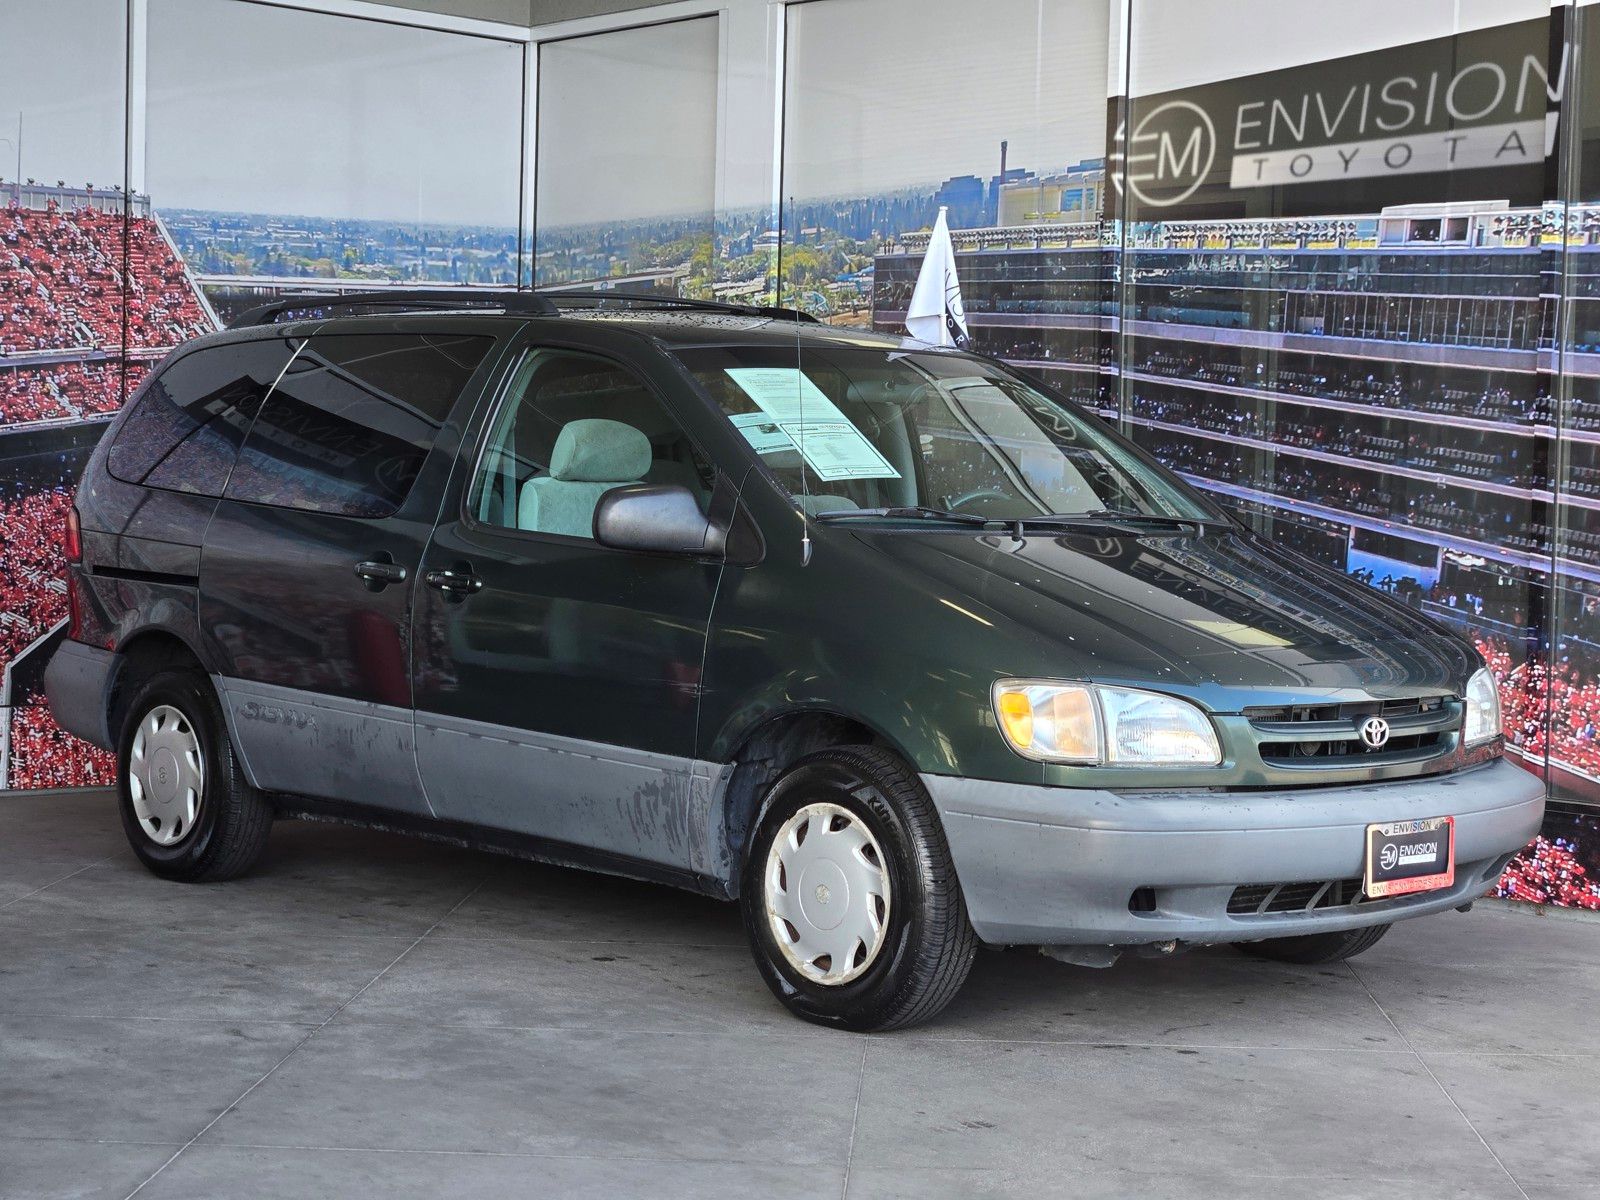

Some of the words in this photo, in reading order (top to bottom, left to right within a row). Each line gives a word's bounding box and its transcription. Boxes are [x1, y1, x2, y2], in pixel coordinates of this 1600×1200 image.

[1234, 42, 1569, 149] ENVISION
[1252, 129, 1526, 181] TOYOTA
[1393, 820, 1431, 834] ENVISION
[1399, 842, 1437, 857] ENVISION
